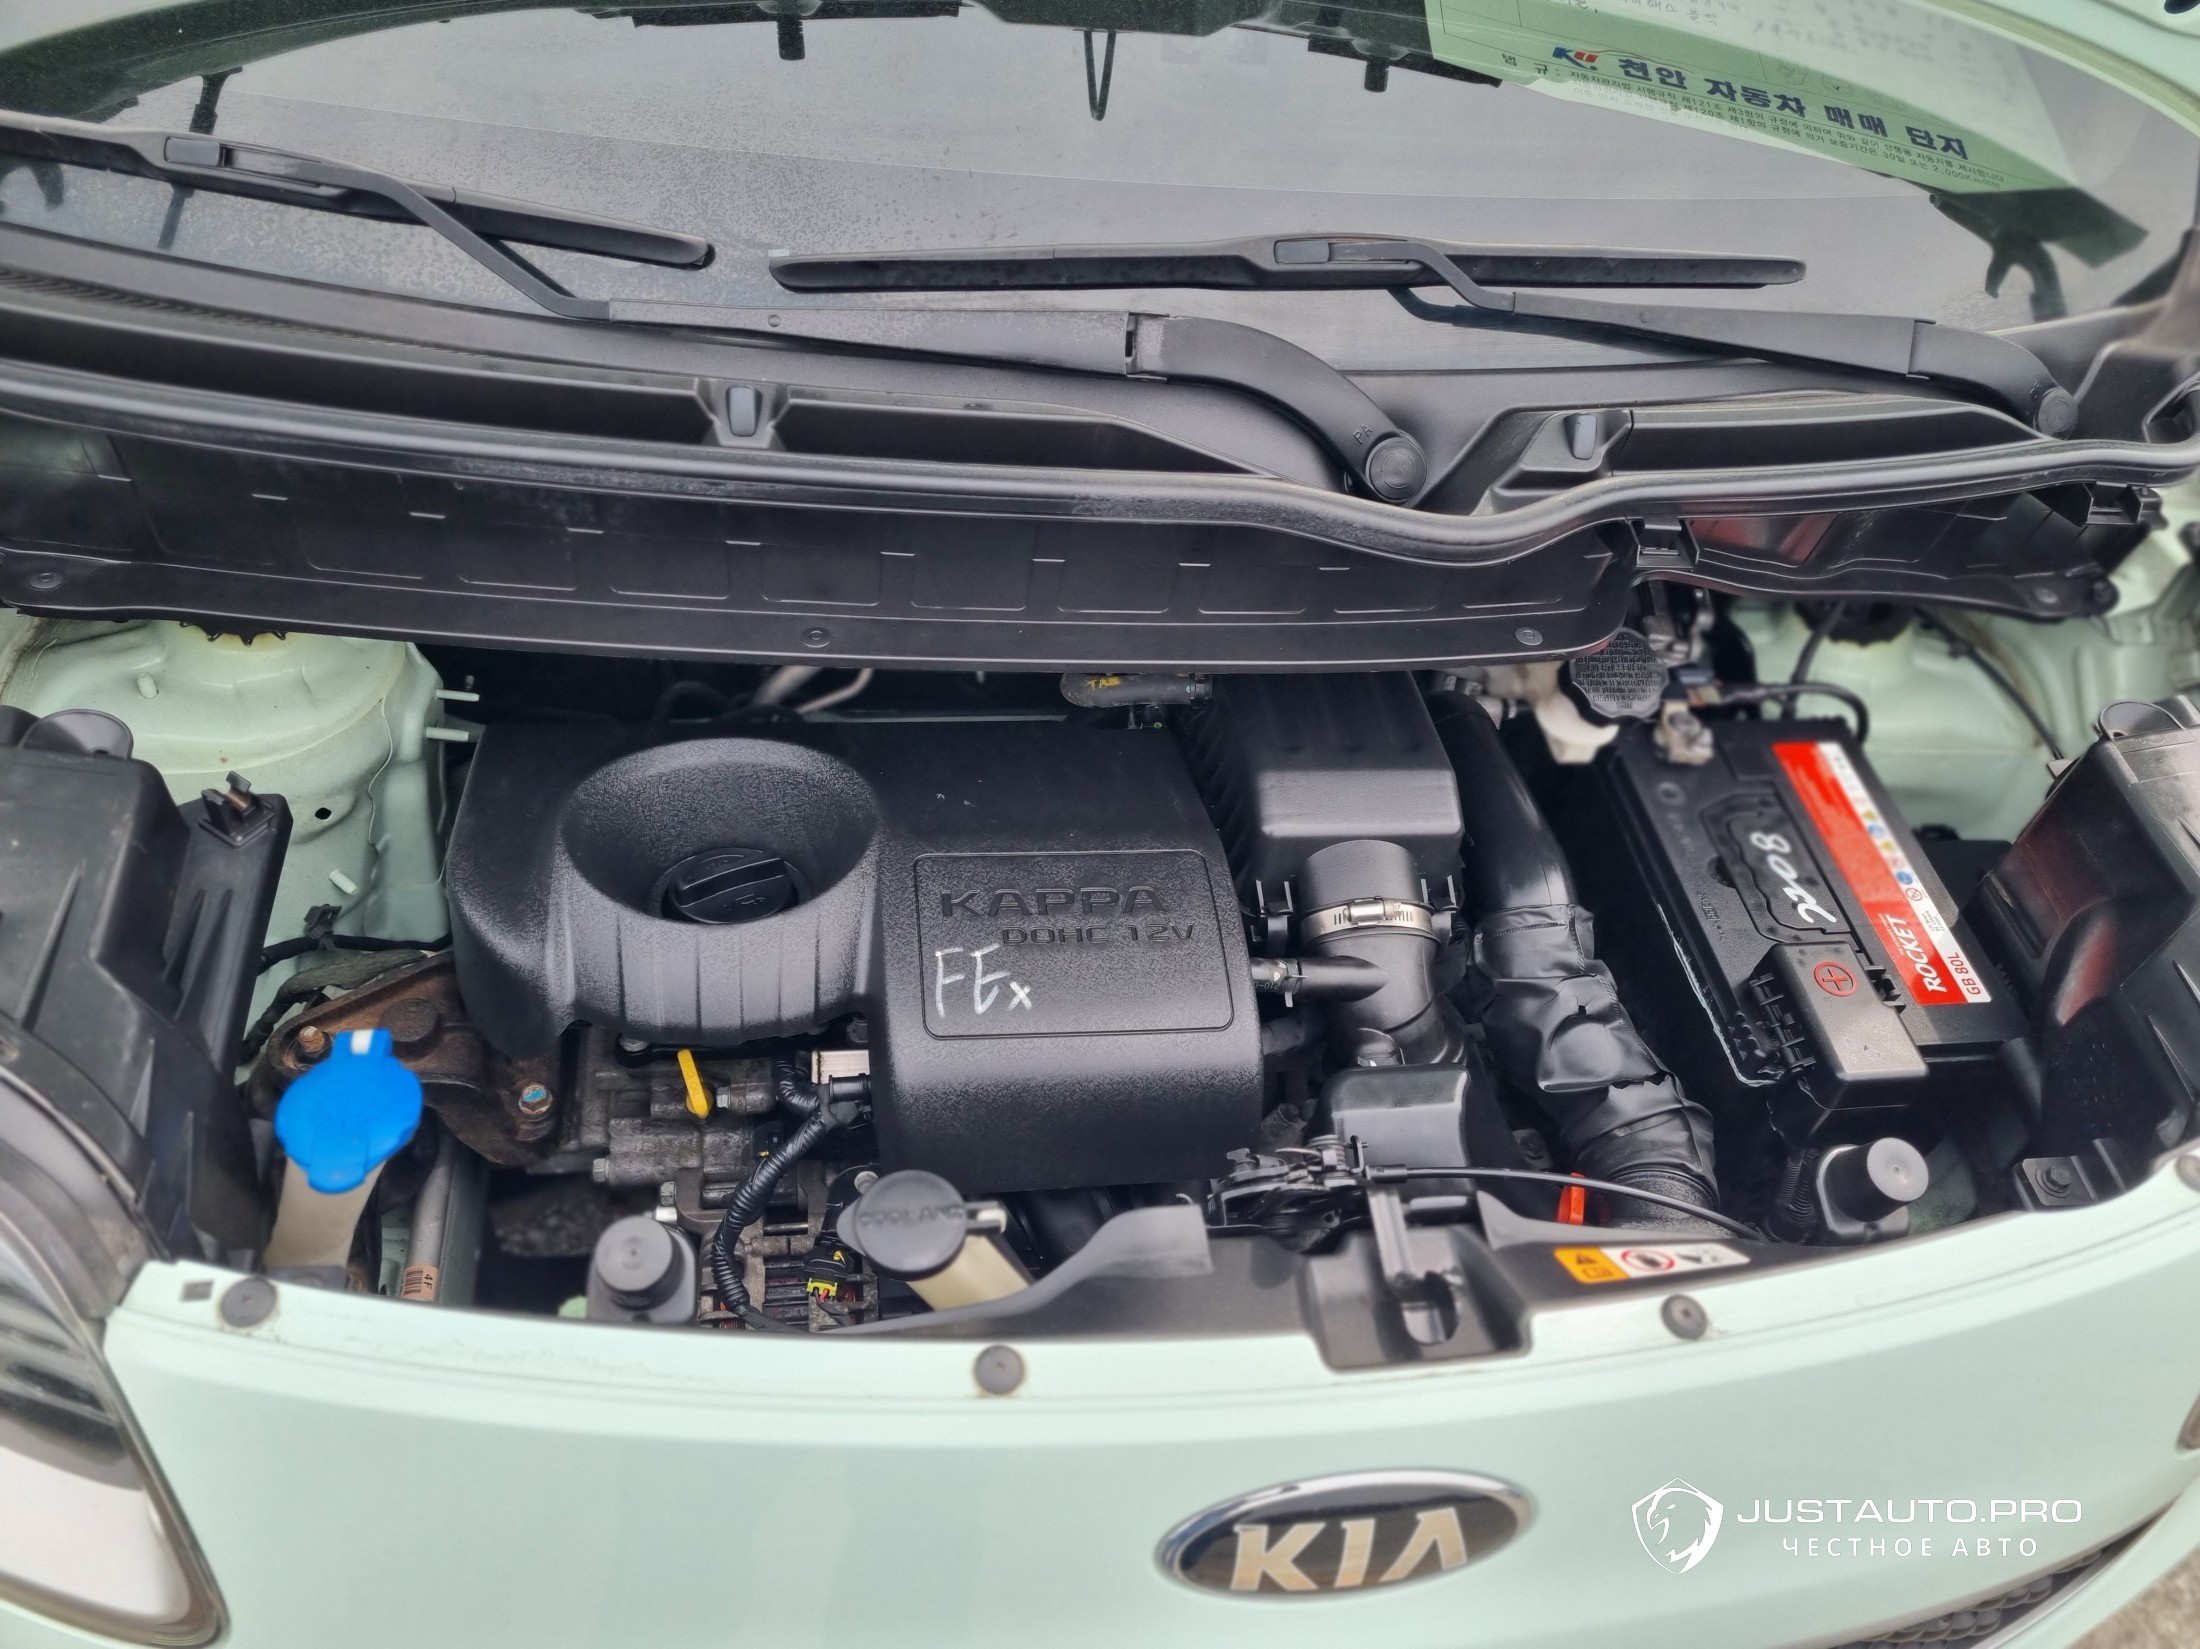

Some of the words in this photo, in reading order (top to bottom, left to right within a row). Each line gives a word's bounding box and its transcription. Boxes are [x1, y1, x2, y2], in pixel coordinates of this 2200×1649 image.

[1502, 53, 1517, 67] 법
[1569, 70, 1632, 91] 자동차관리법
[1636, 83, 1677, 100] 시행규칙
[1681, 96, 1723, 111] 제121조
[1769, 116, 1798, 128] 규정에
[1803, 123, 1832, 137] 의하여
[1618, 57, 1688, 90] 천안
[1703, 78, 1807, 118] 자동차
[1823, 105, 1888, 138] 매매
[1905, 125, 1969, 160] 단지
[1771, 125, 1800, 138] 규정에
[940, 885, 1168, 917] KAPPA
[1000, 924, 1110, 945] DOHC
[1126, 922, 1195, 943] 12V
[1884, 913, 1948, 993] ROCKET
[1947, 952, 1970, 975] 80L
[1961, 977, 1982, 996] GB
[1229, 1506, 1469, 1592] KIA
